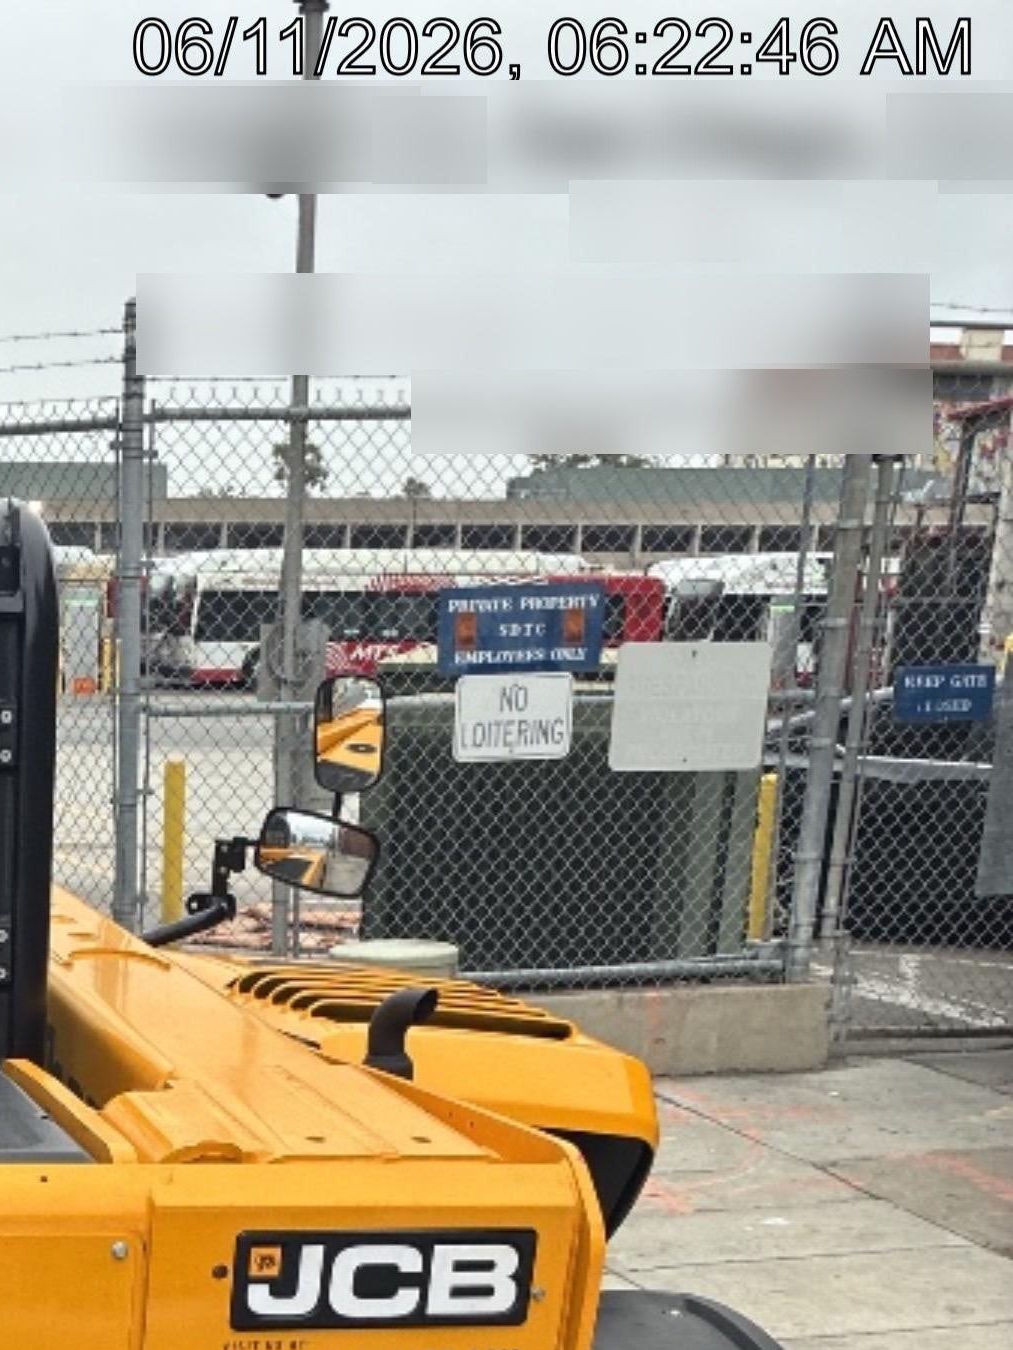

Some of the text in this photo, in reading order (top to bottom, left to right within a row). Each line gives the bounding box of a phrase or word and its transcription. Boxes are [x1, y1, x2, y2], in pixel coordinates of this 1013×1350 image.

[448, 594, 600, 613] PRIVATE PROPERTY
[454, 646, 588, 664] EMPLOYEES ONLY
[950, 674, 987, 688] GATE
[499, 685, 528, 712] NO
[460, 719, 565, 749] LOITERING
[247, 1243, 520, 1318] JCB
